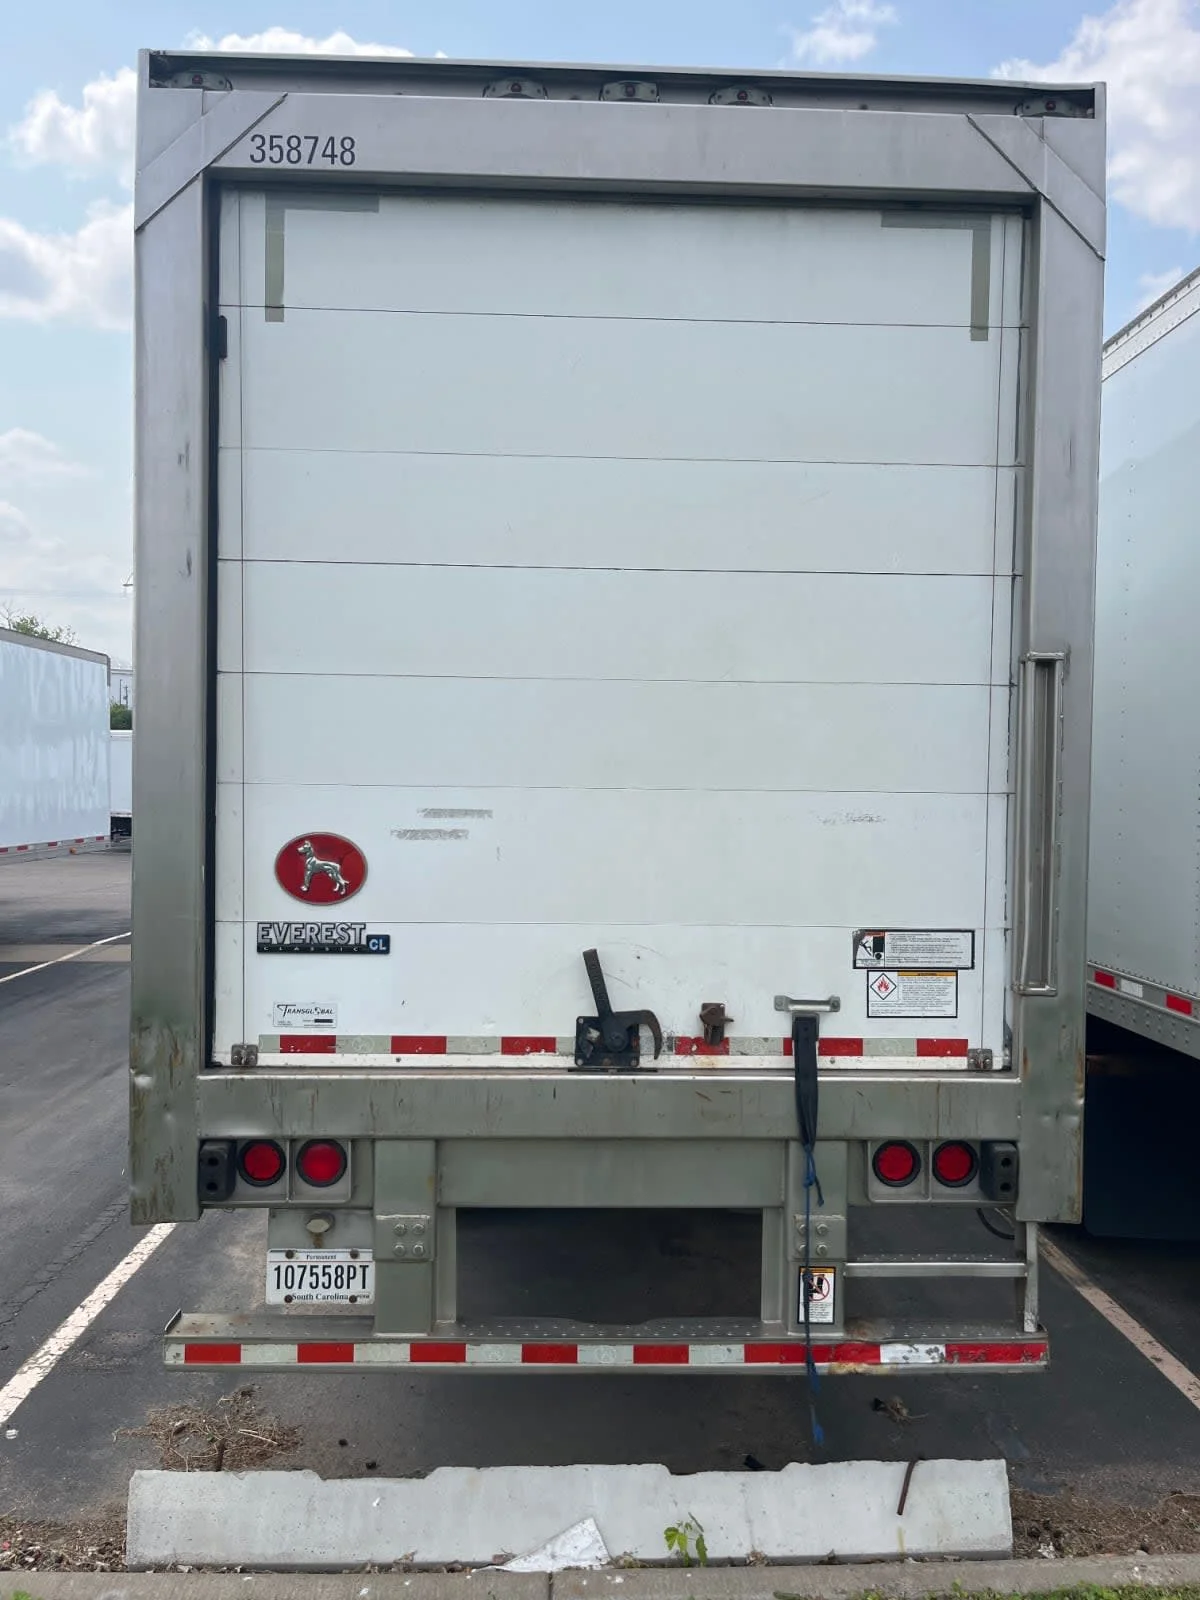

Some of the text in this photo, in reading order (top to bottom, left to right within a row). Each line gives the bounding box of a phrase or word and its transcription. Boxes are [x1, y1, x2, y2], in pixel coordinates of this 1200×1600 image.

[249, 133, 356, 166] 358748
[257, 922, 366, 945] EVEREST
[368, 938, 387, 951] CL
[273, 1264, 370, 1290] 107558PT
[292, 1293, 314, 1301] South
[315, 1293, 349, 1301] Carolina
